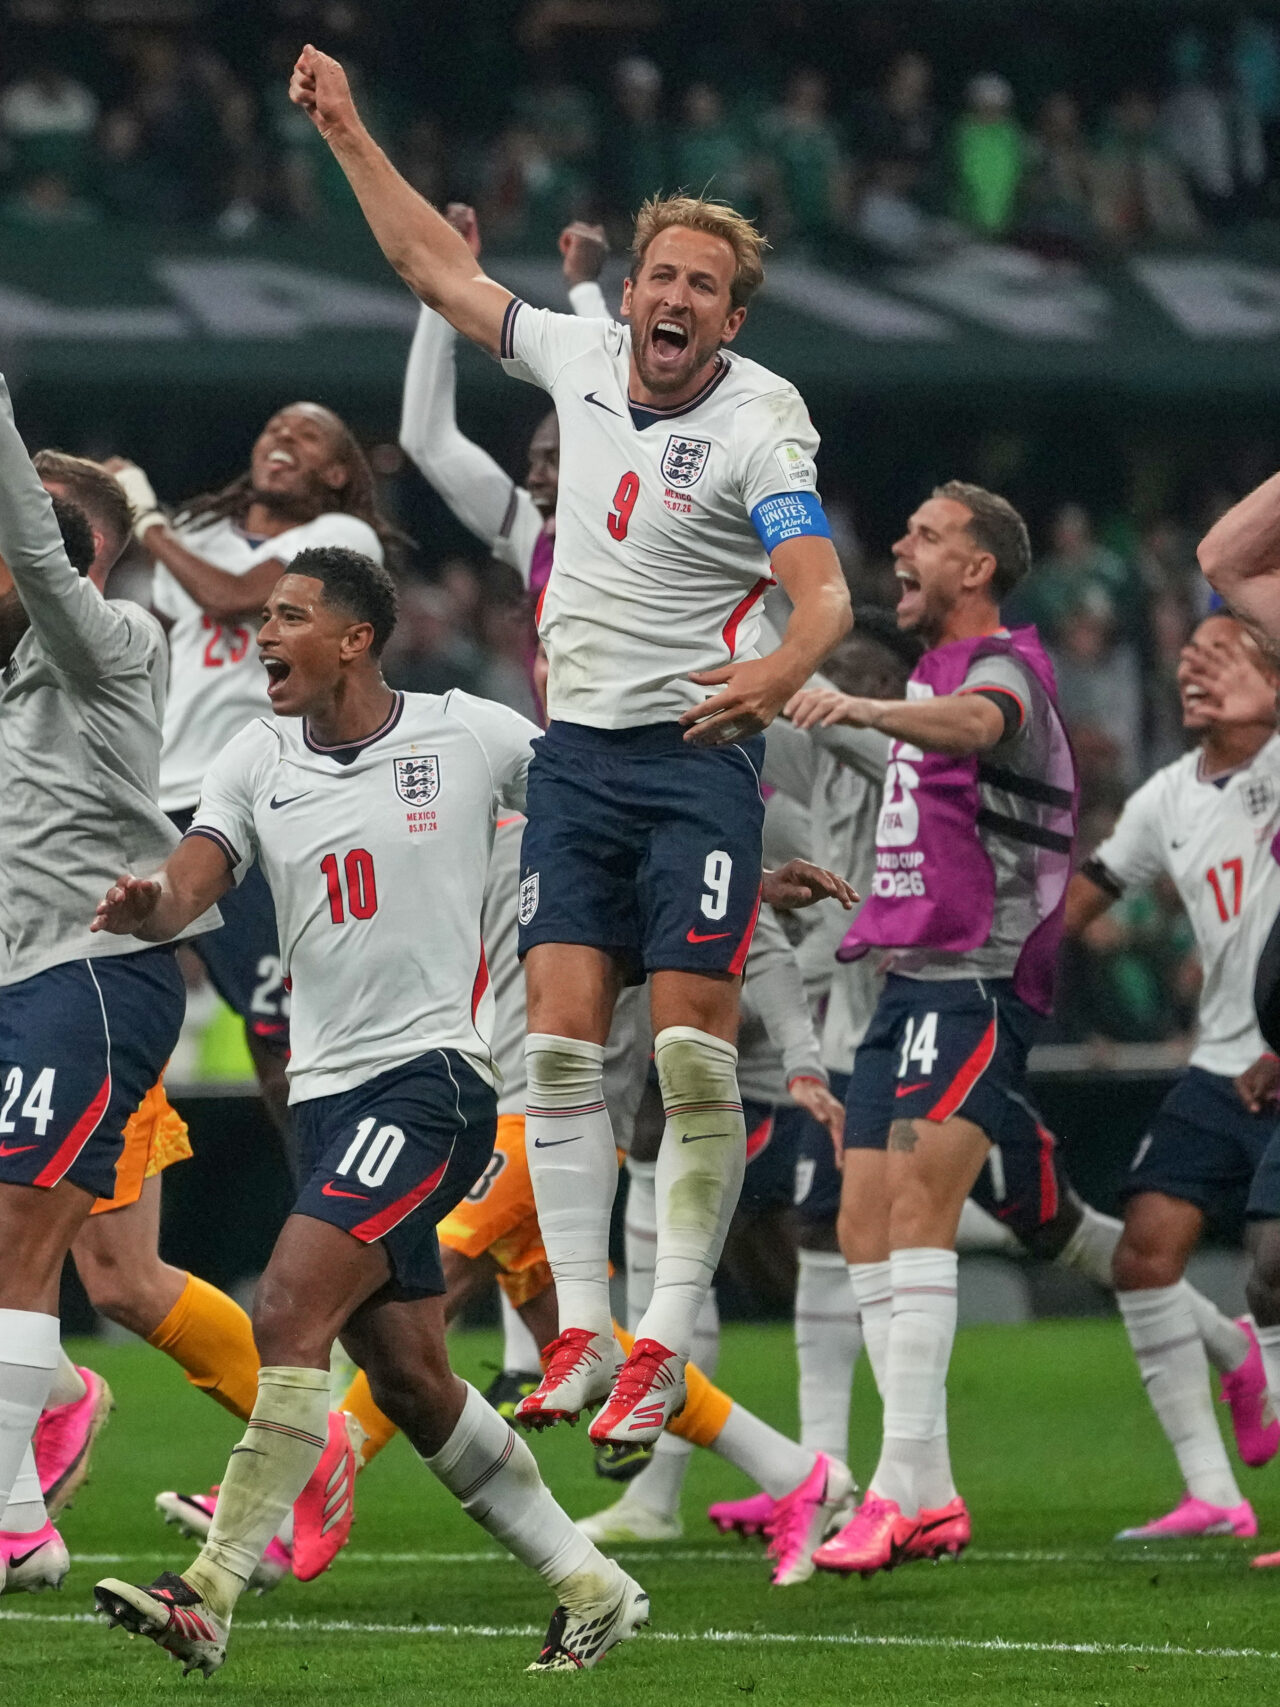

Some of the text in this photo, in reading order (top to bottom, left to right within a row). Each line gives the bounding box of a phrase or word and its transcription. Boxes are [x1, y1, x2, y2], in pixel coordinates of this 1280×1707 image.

[606, 470, 640, 542] 9
[664, 488, 693, 502] MEXICO
[757, 495, 804, 517] FOOTBALL
[761, 504, 808, 527] UNITES
[766, 515, 813, 538] the World
[406, 810, 437, 822] MEXICO
[319, 847, 379, 925] 10
[700, 849, 733, 921] 9
[899, 851, 926, 869] CUP
[1205, 856, 1244, 923] 17
[251, 954, 291, 1018] 2
[897, 1011, 939, 1078] 14
[335, 1116, 406, 1188] 10
